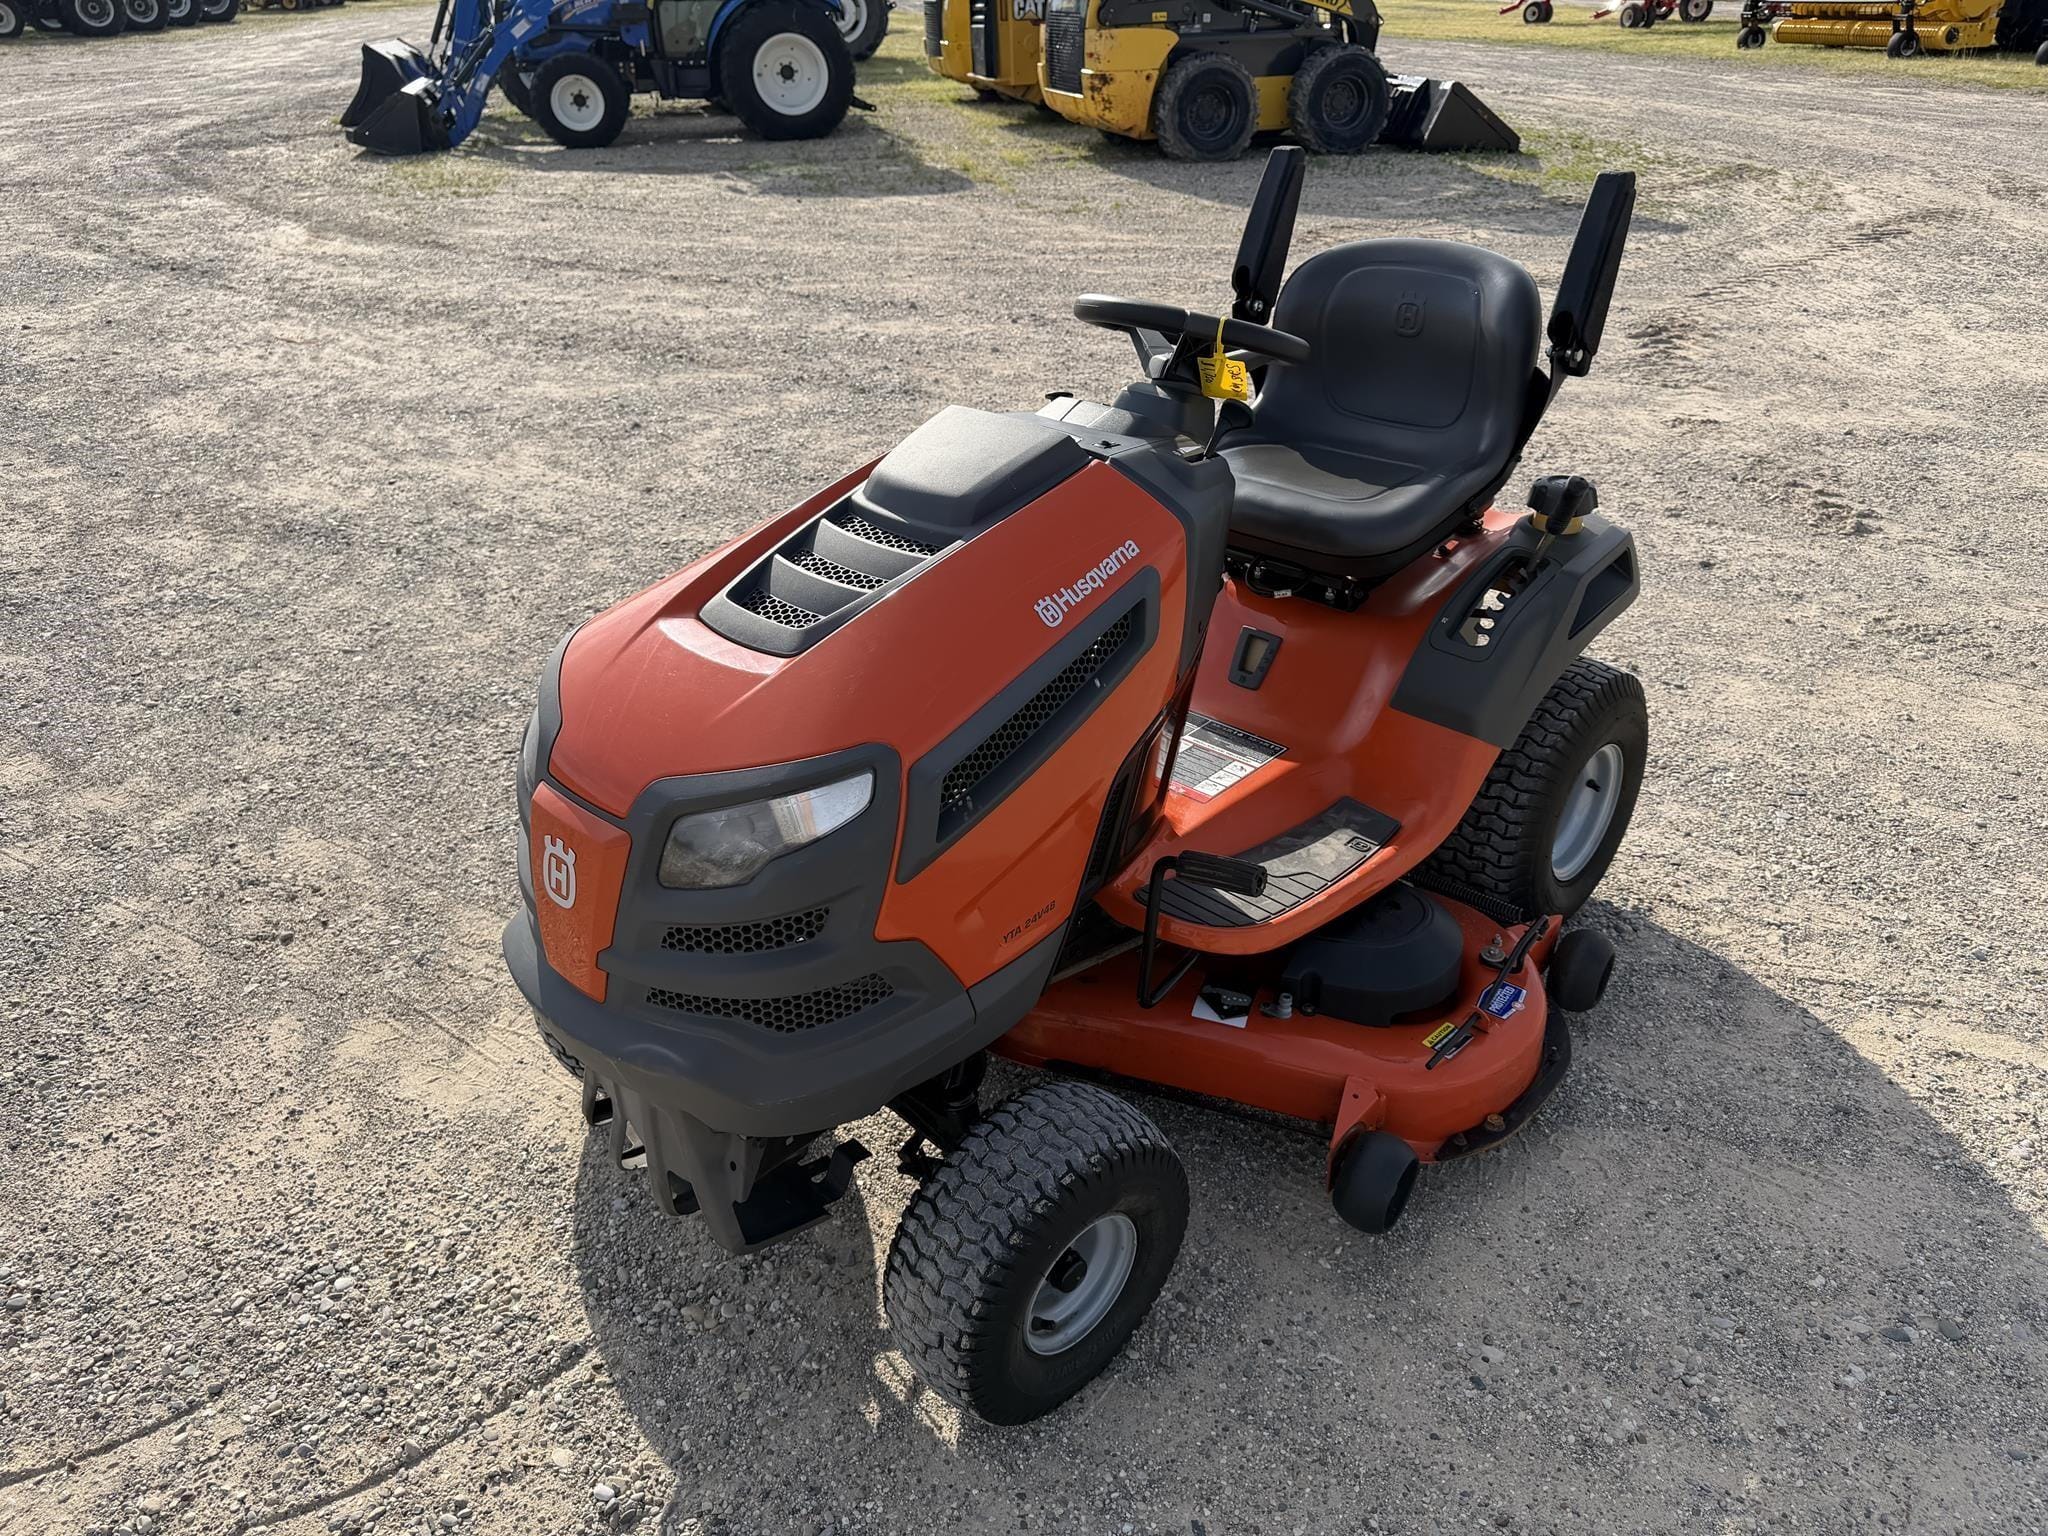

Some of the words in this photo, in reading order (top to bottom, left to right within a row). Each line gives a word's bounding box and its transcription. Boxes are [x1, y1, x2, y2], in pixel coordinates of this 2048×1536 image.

[1013, 0, 1045, 20] CAT
[1053, 539, 1141, 613] Husqvarna
[1002, 925, 1022, 944] YTA
[1488, 985, 1516, 1014] PROTECTED
[1431, 1024, 1452, 1041] CAUTION
